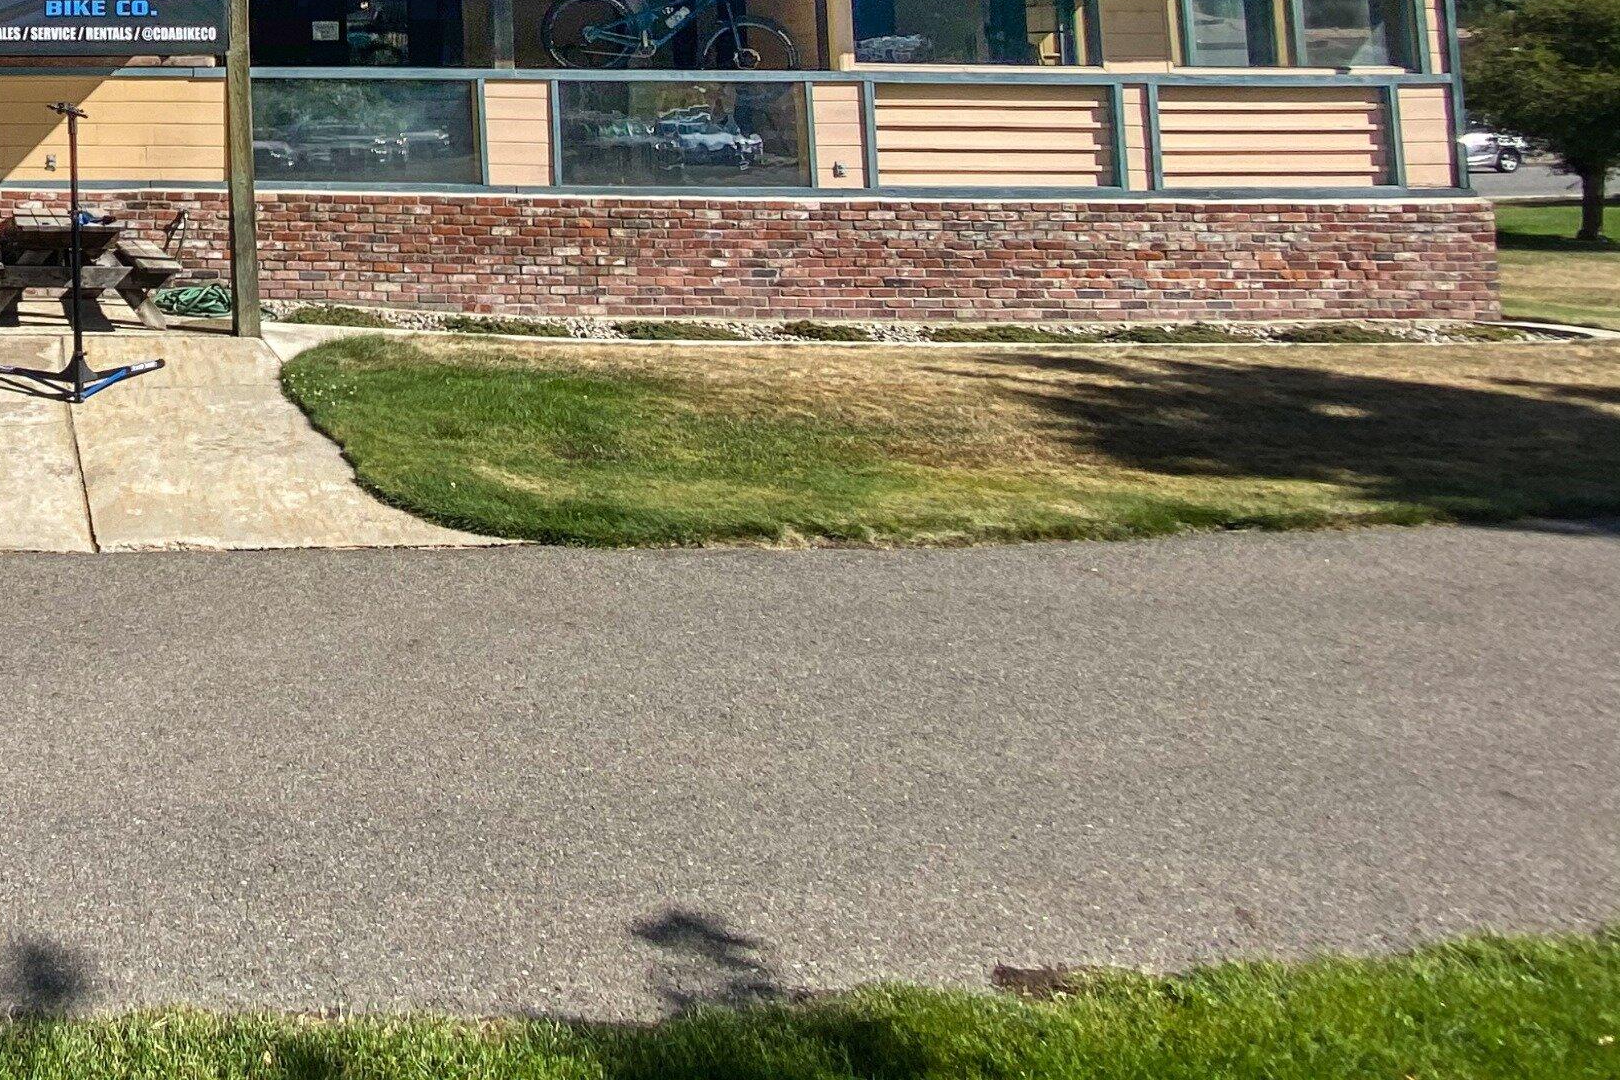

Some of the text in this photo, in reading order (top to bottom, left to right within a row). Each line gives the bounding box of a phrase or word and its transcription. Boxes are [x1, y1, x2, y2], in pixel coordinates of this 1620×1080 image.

[45, 0, 158, 17] BIKE CO.
[30, 26, 77, 41] SERVICE
[85, 26, 133, 41] RENTALS
[141, 26, 217, 41] @CDABIKECO
